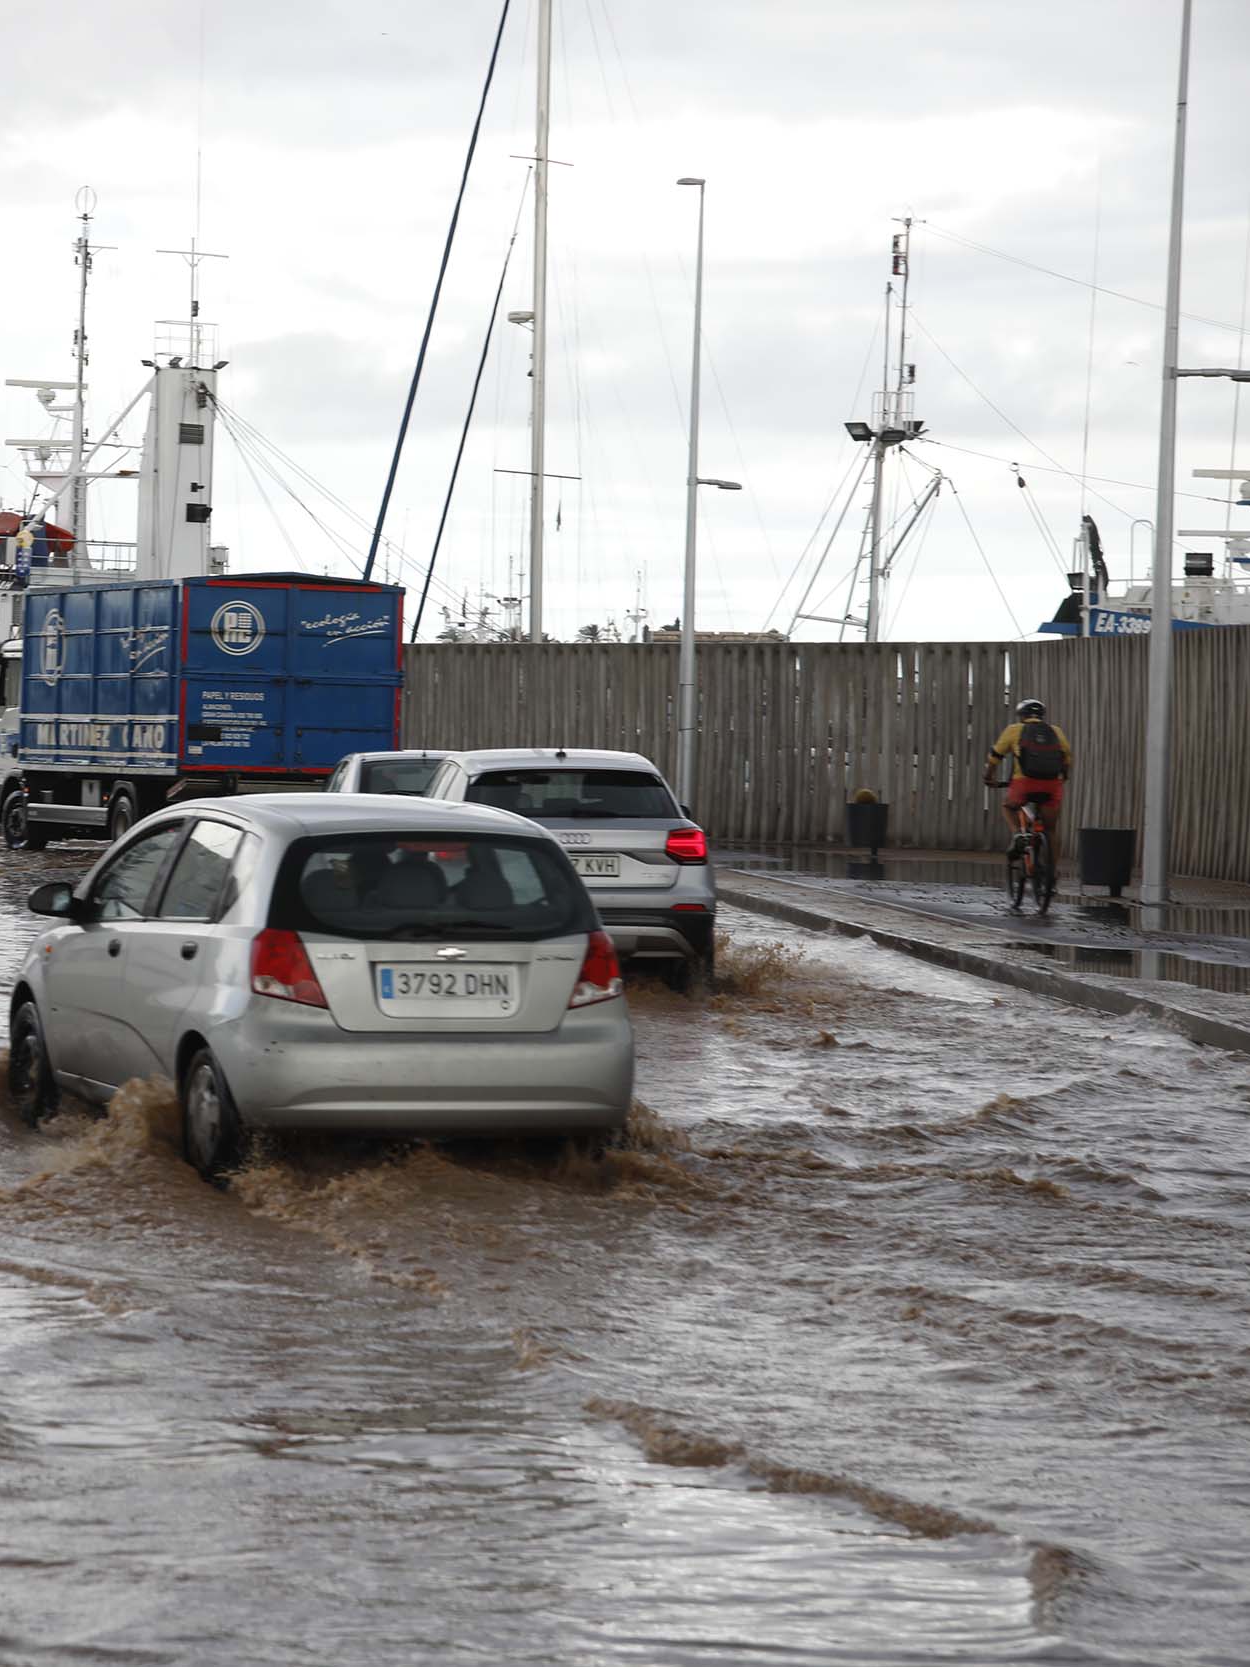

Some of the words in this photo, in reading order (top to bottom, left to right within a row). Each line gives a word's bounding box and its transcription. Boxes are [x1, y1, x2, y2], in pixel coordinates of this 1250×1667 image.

[37, 723, 111, 747] MARTINEZ
[585, 858, 616, 873] KVH
[397, 973, 457, 996] 3792
[464, 974, 510, 996] DHN
